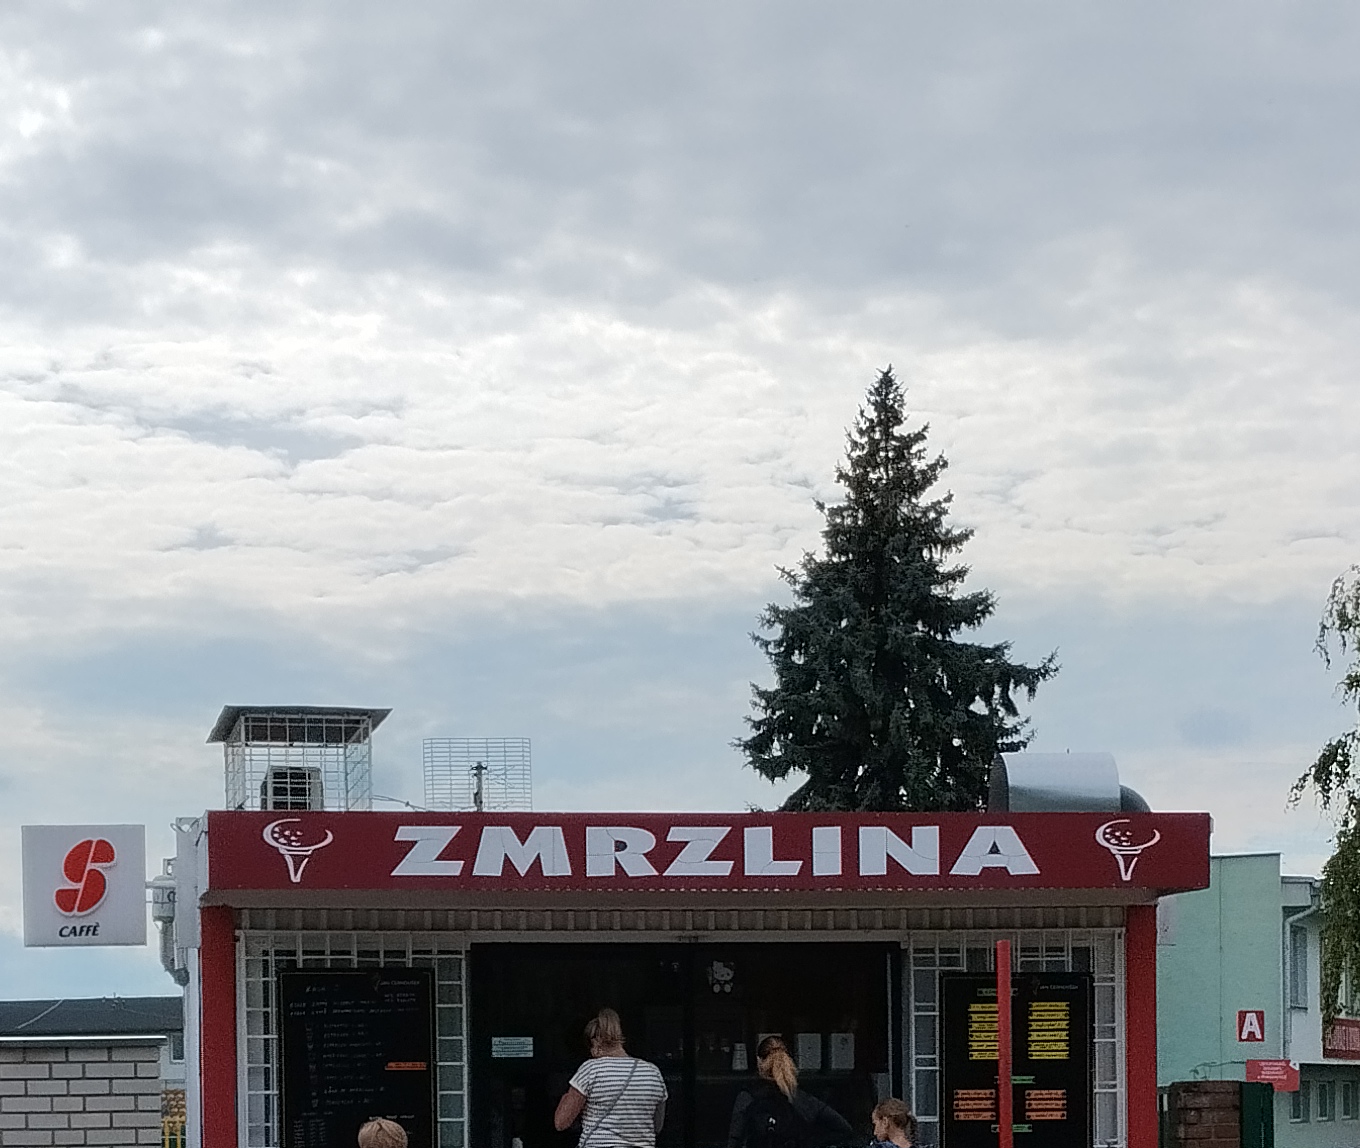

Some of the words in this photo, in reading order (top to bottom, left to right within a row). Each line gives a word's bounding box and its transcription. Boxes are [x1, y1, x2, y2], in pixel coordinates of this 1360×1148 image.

[391, 825, 1041, 877] ZMRZLINA
[58, 922, 101, 937] CAFFÈ
[1241, 1012, 1262, 1040] A
